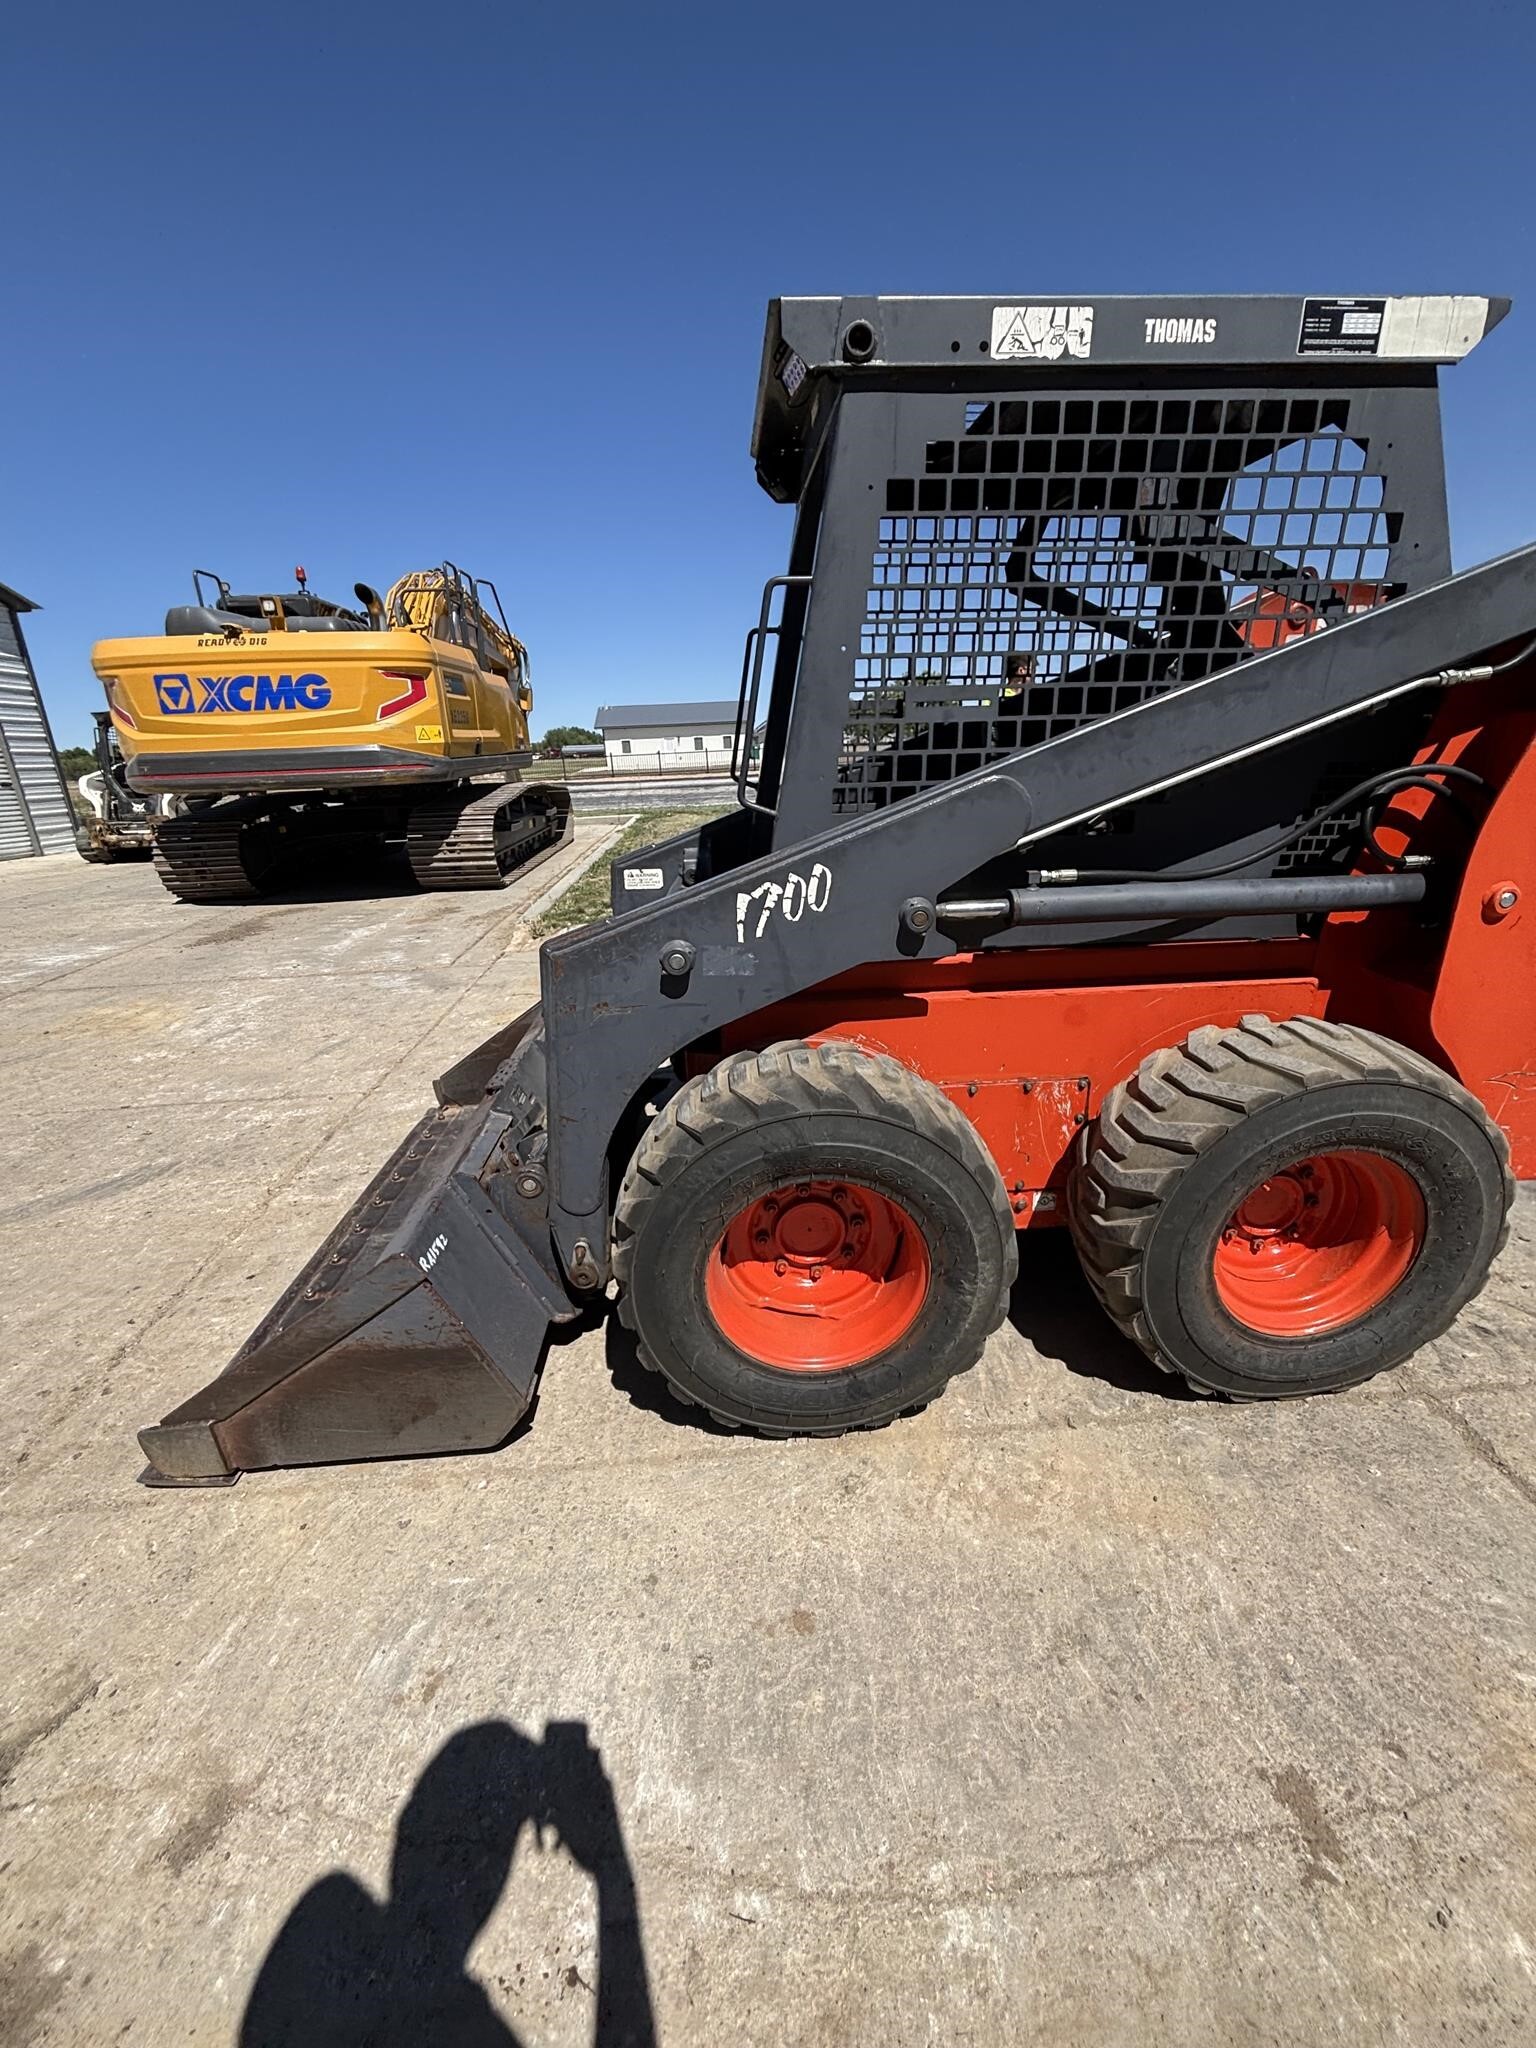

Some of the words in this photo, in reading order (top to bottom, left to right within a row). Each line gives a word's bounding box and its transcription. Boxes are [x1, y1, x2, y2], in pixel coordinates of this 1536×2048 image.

[1144, 318, 1217, 343] THOMAS
[197, 637, 231, 647] READY
[249, 637, 268, 646] DIG
[196, 673, 332, 713] XCMG
[736, 863, 832, 943] 1700
